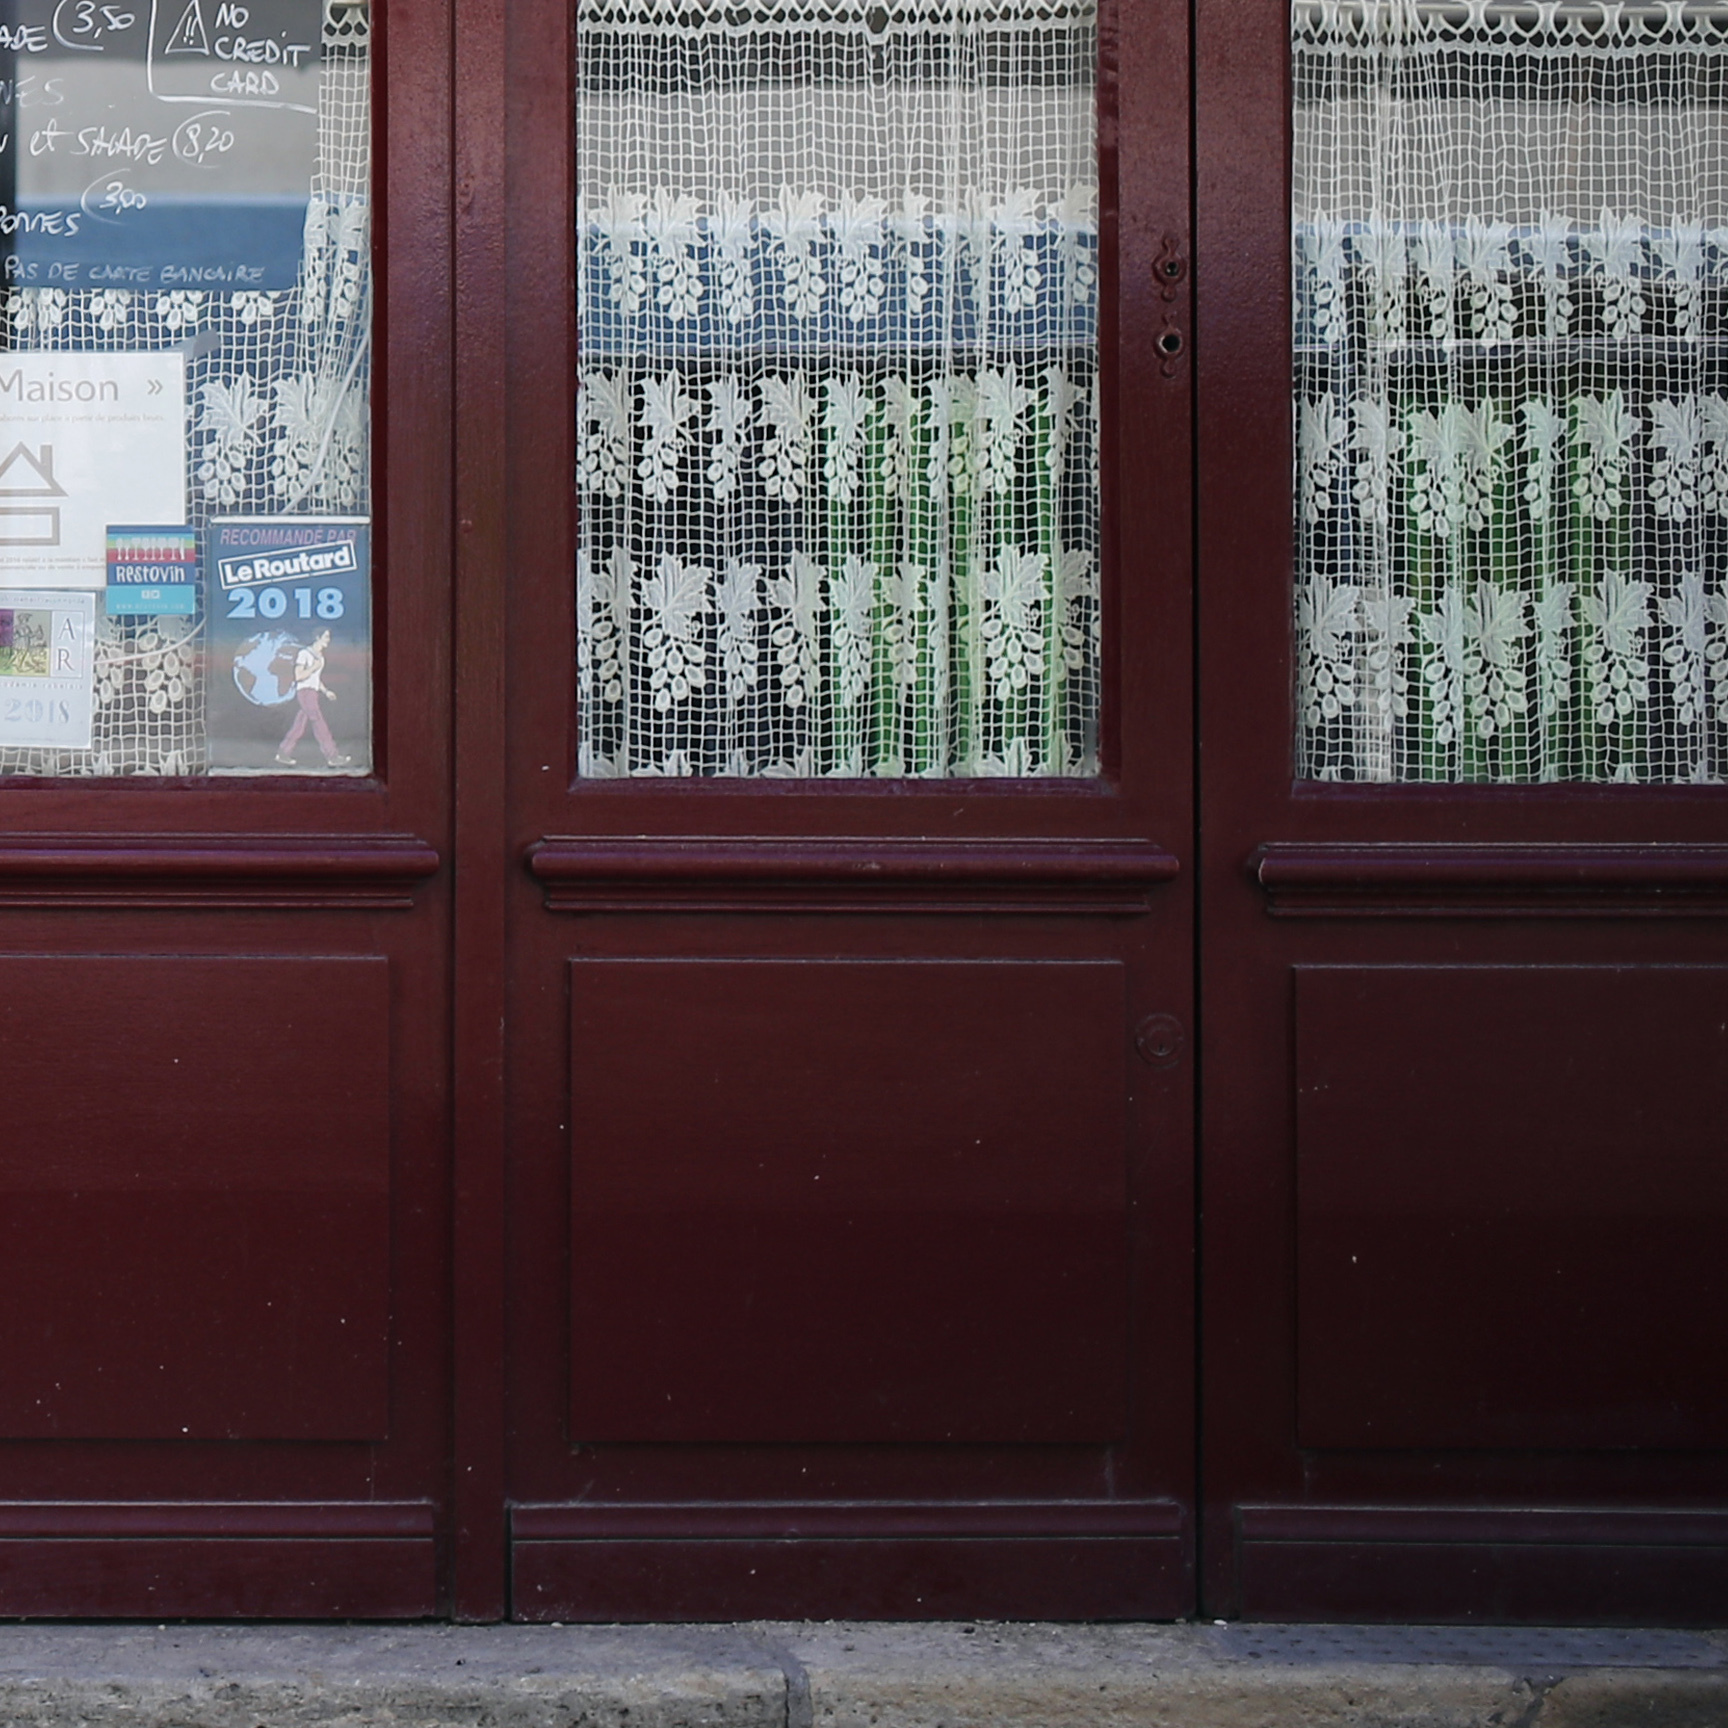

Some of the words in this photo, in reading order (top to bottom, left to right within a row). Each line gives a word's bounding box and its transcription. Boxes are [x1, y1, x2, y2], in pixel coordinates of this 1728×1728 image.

[214, 1, 250, 29] NO
[213, 29, 312, 67] CREDIT
[210, 69, 281, 95] CARD
[28, 118, 69, 158] et
[68, 124, 167, 166] SALADE
[181, 125, 236, 164] 8,20
[98, 180, 149, 215] 3,00
[3, 253, 40, 283] PAS
[47, 263, 80, 282] DE
[88, 264, 150, 284] CARTE
[159, 265, 265, 284] BANCAIRE
[326, 529, 357, 546] PAR
[225, 586, 345, 620] 2018
[3, 697, 71, 724] 2018
